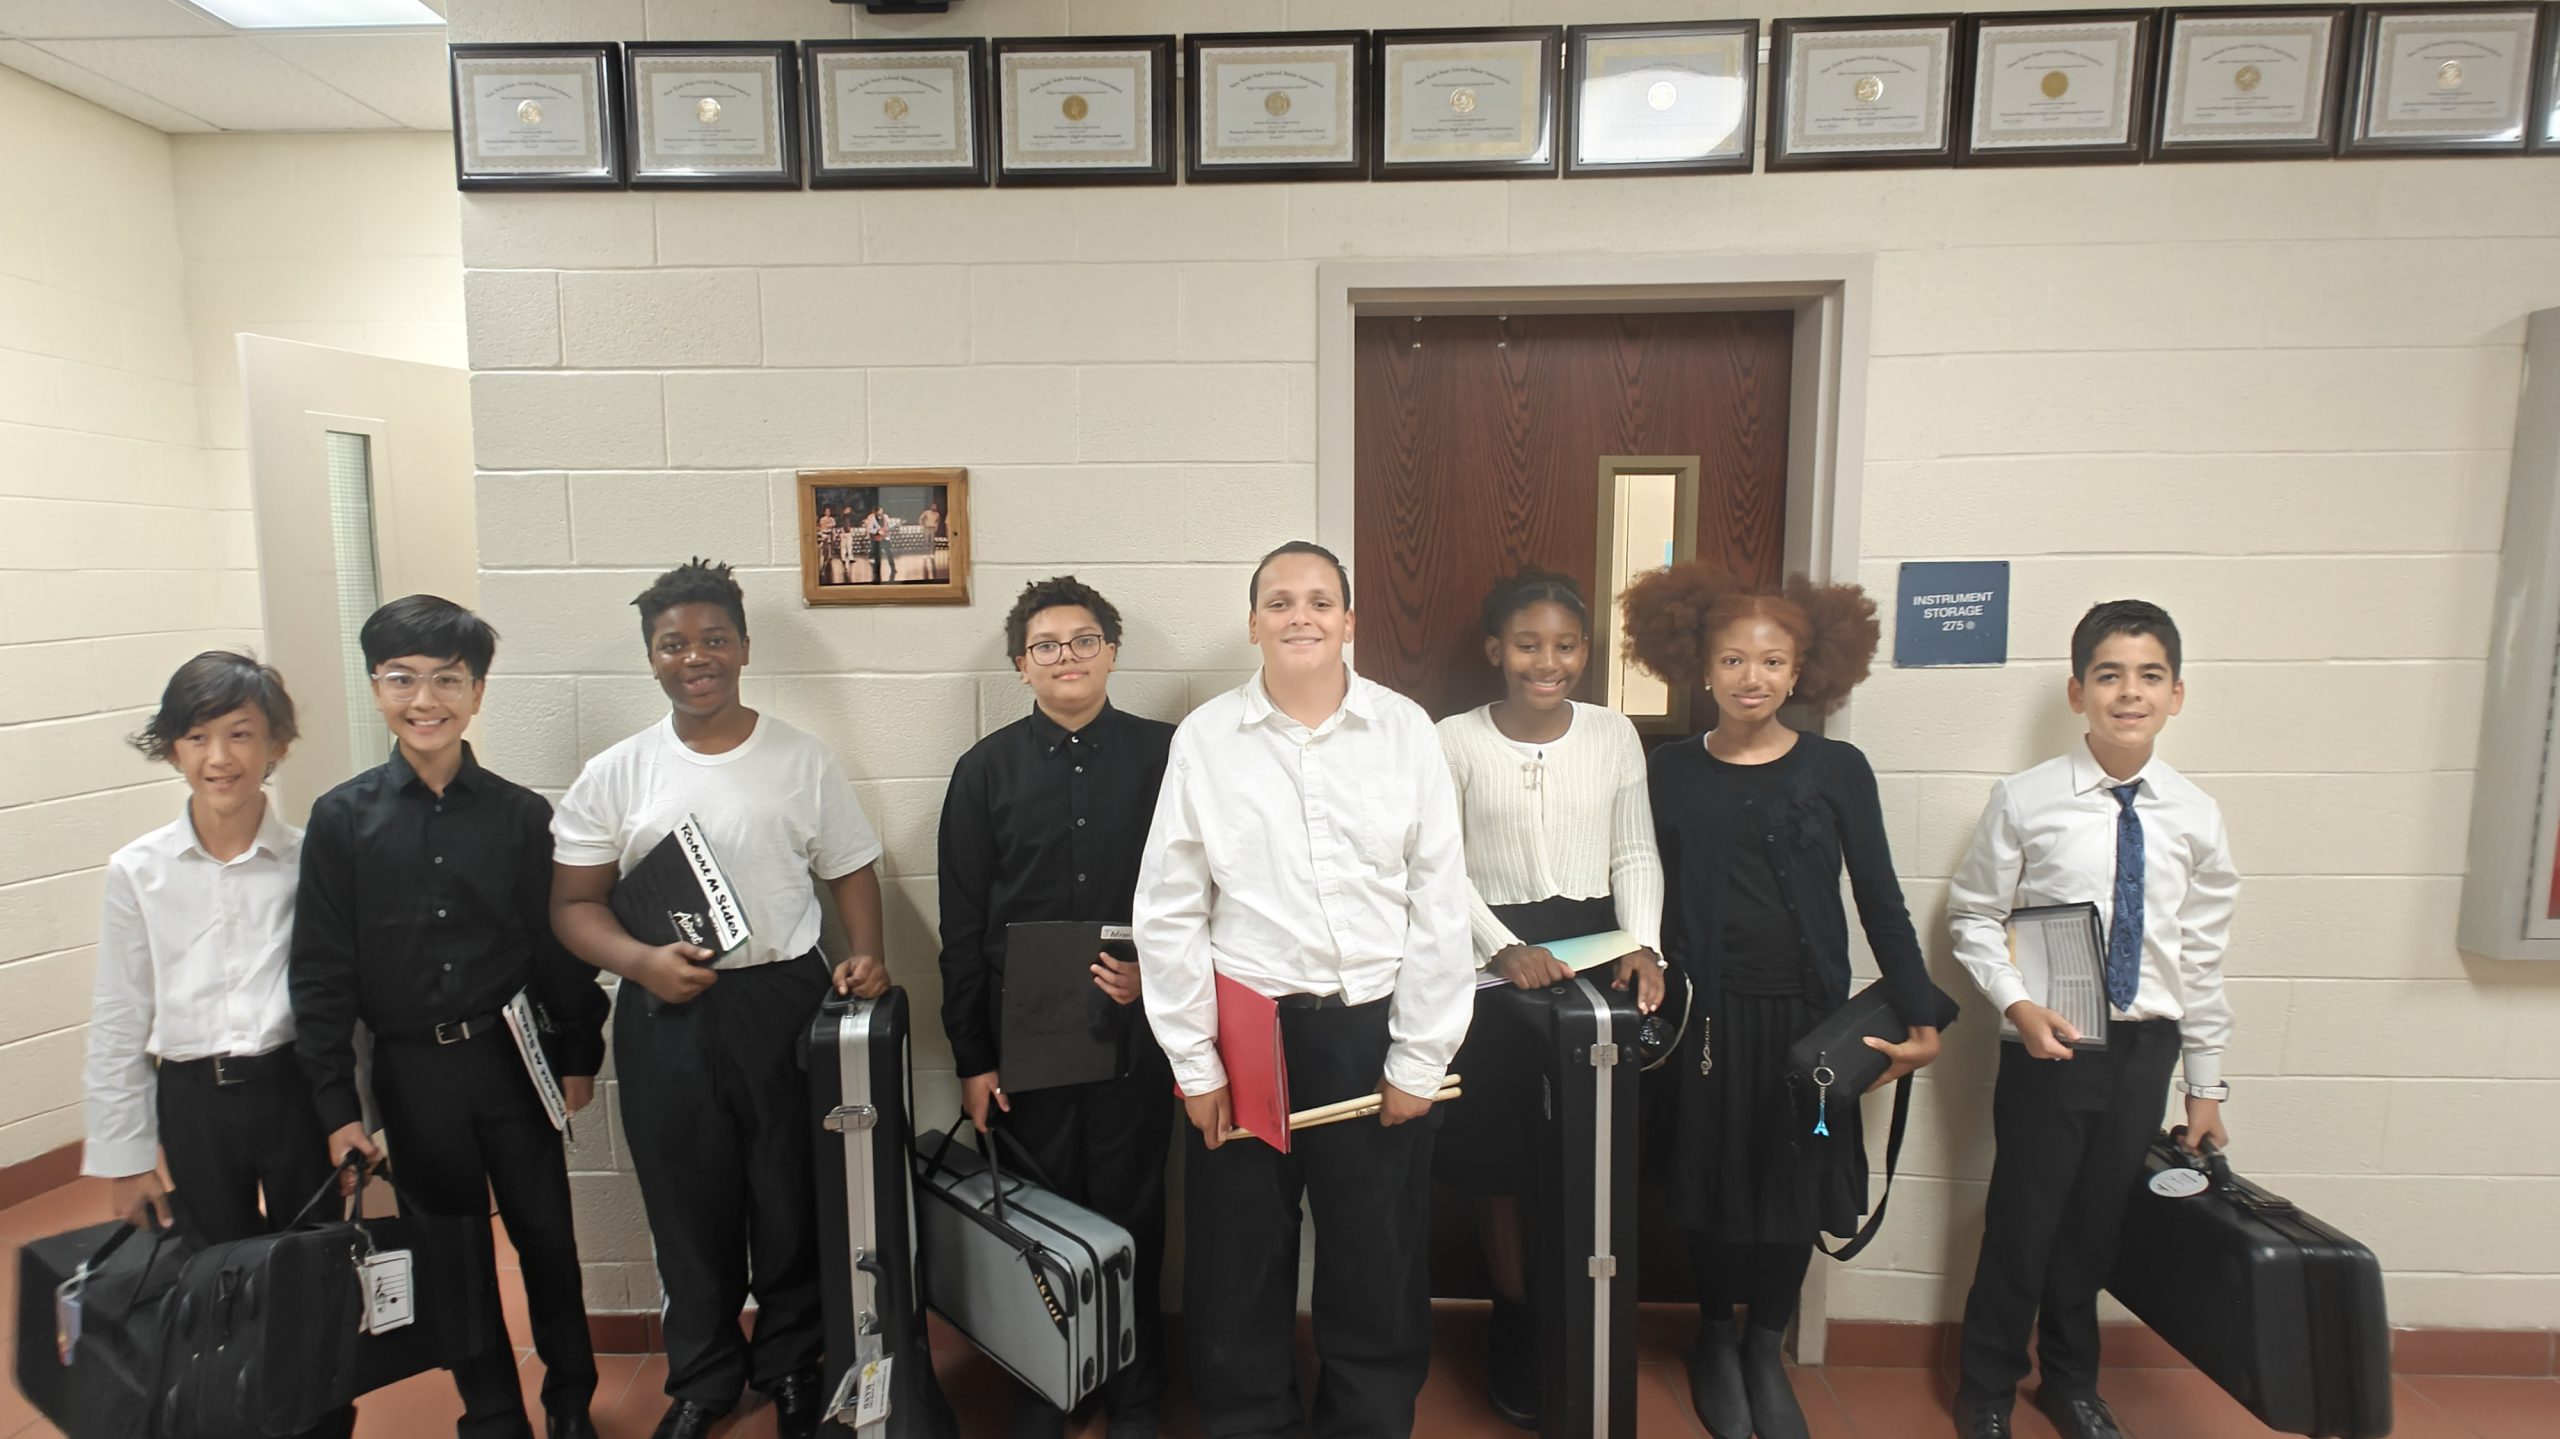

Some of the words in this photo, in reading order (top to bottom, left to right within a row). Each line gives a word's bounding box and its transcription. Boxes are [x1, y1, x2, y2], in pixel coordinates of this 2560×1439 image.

[1913, 591, 1994, 606] INSTRUMENT
[1923, 605, 1984, 619] STORAGE
[1942, 620, 1964, 631] 275
[681, 823, 711, 876] Robert
[706, 878, 719, 892] M
[716, 894, 740, 939] Sides
